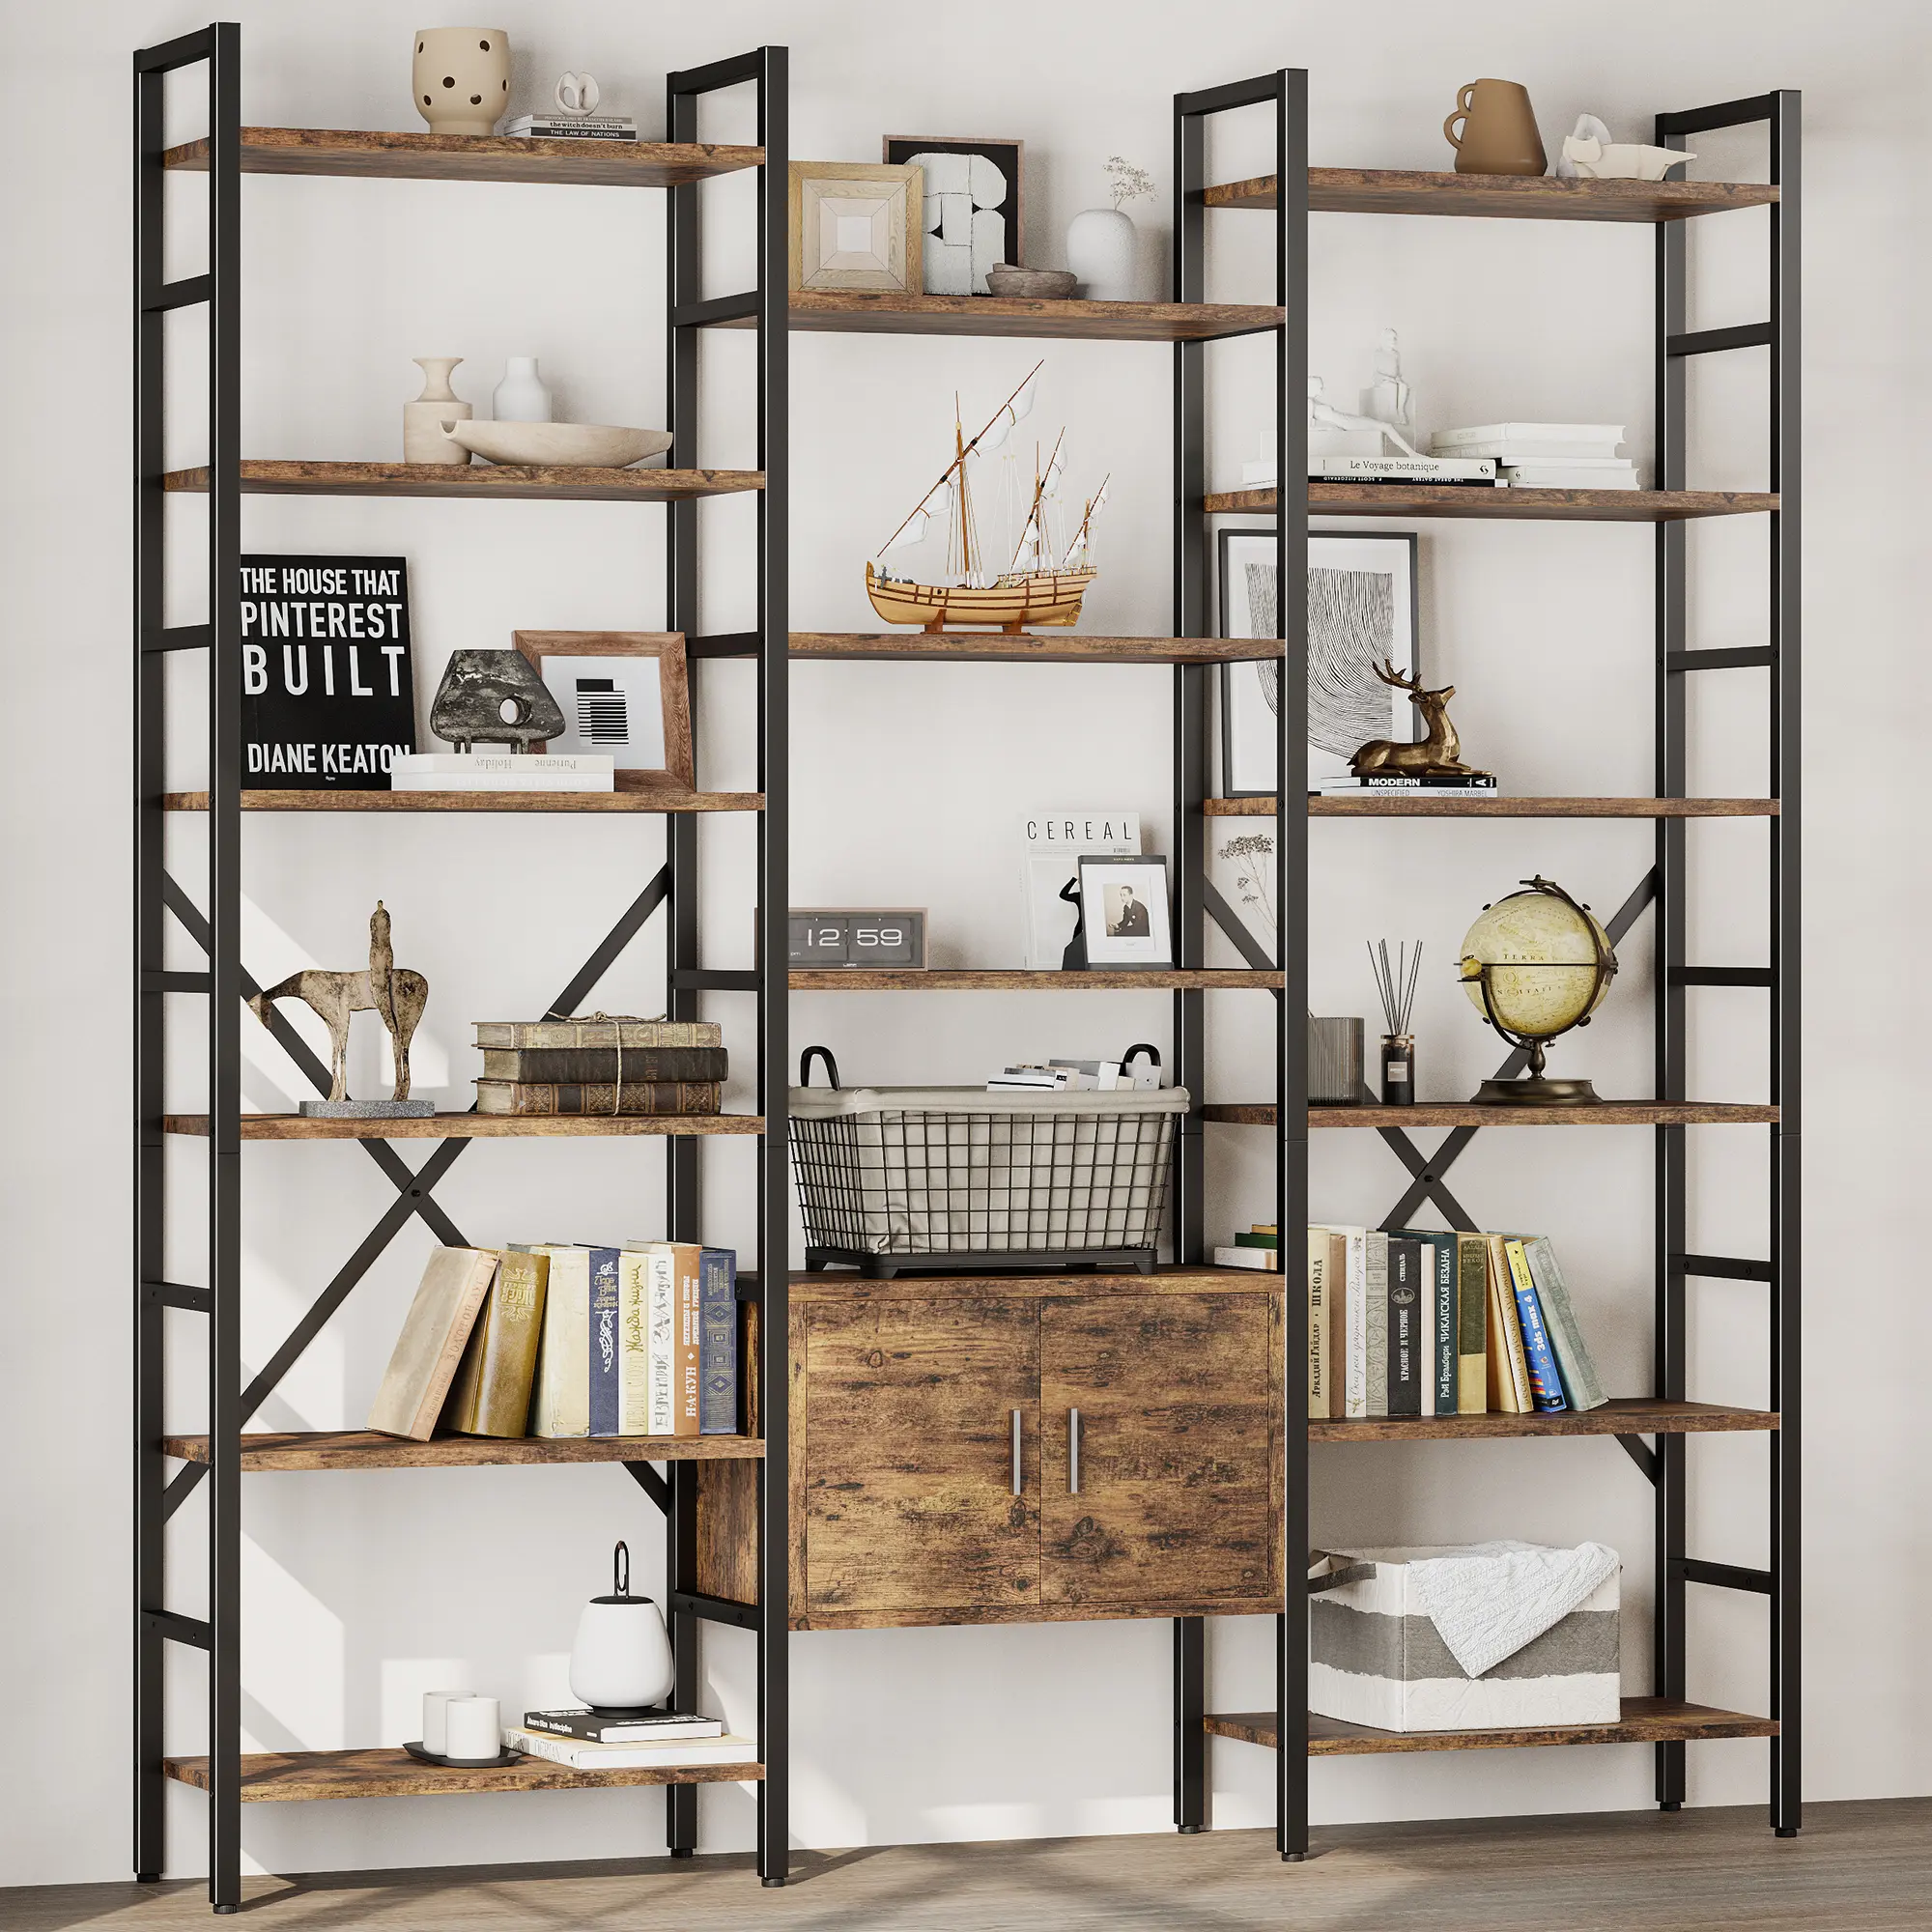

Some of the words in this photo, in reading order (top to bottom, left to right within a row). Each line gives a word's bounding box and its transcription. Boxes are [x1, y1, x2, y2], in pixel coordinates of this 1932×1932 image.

[1350, 461, 1360, 469] Le
[1362, 461, 1394, 471] Voyage
[1396, 462, 1439, 471] botanique
[241, 567, 277, 594] THE
[282, 568, 347, 595] HOUSE
[351, 569, 400, 595] THAT
[241, 601, 403, 639] PINTEREST
[242, 644, 405, 696] BUILT
[247, 743, 317, 773] DIANE
[474, 756, 512, 770] Holiday
[1368, 778, 1420, 786] MODERN
[1027, 821, 1132, 840] CEREAL
[1440, 1248, 1450, 1285] БЕЗДНА
[1312, 1259, 1322, 1307] ШКОЛА
[1523, 1294, 1533, 1303] 4
[1400, 1309, 1408, 1339] ЧЕРНОЕ
[1440, 1286, 1450, 1343] ЧИКАГСКАЯ
[1527, 1305, 1540, 1329] max
[1533, 1331, 1546, 1352] 3ds
[1400, 1348, 1409, 1381] КРАСНОЕ
[1440, 1382, 1450, 1398] Рэй
